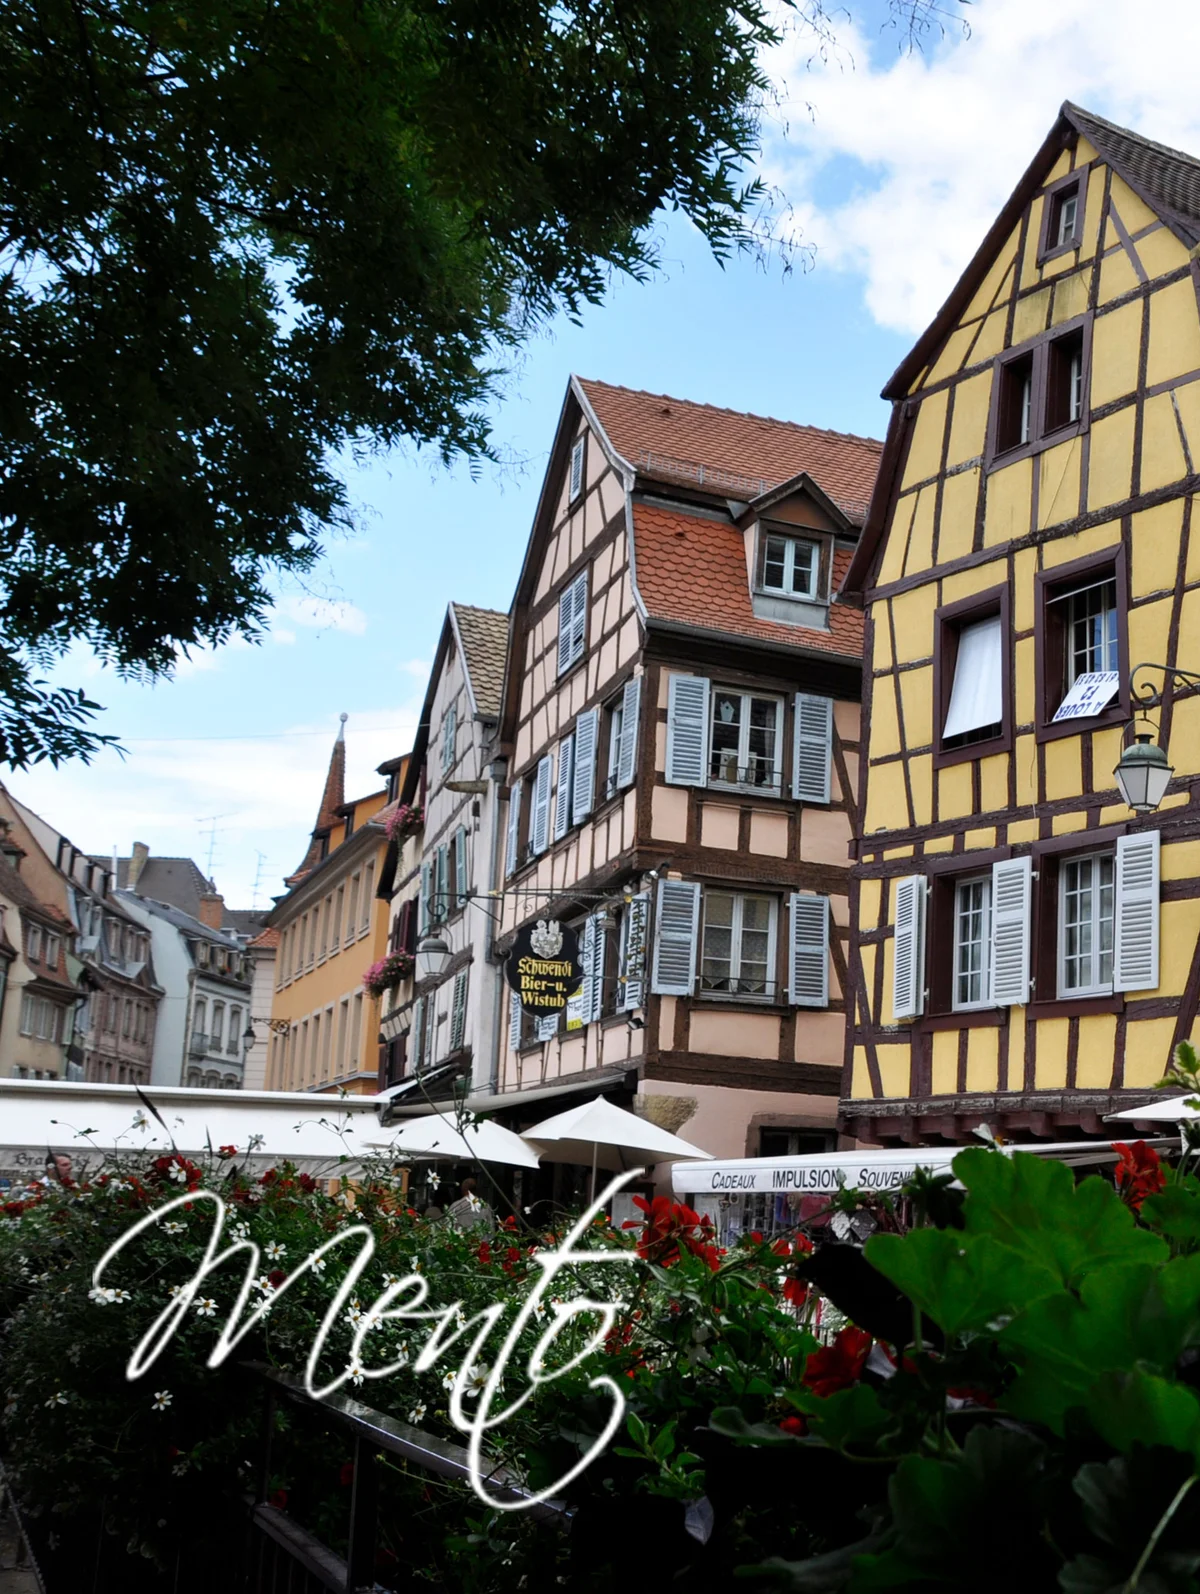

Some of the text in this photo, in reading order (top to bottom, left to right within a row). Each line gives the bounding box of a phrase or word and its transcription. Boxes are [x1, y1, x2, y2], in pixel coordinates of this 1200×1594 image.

[1055, 702, 1092, 720] LOUER
[517, 956, 573, 977] Schwendi
[521, 991, 566, 1008] Wistub
[772, 1169, 841, 1188] IMPULSION
